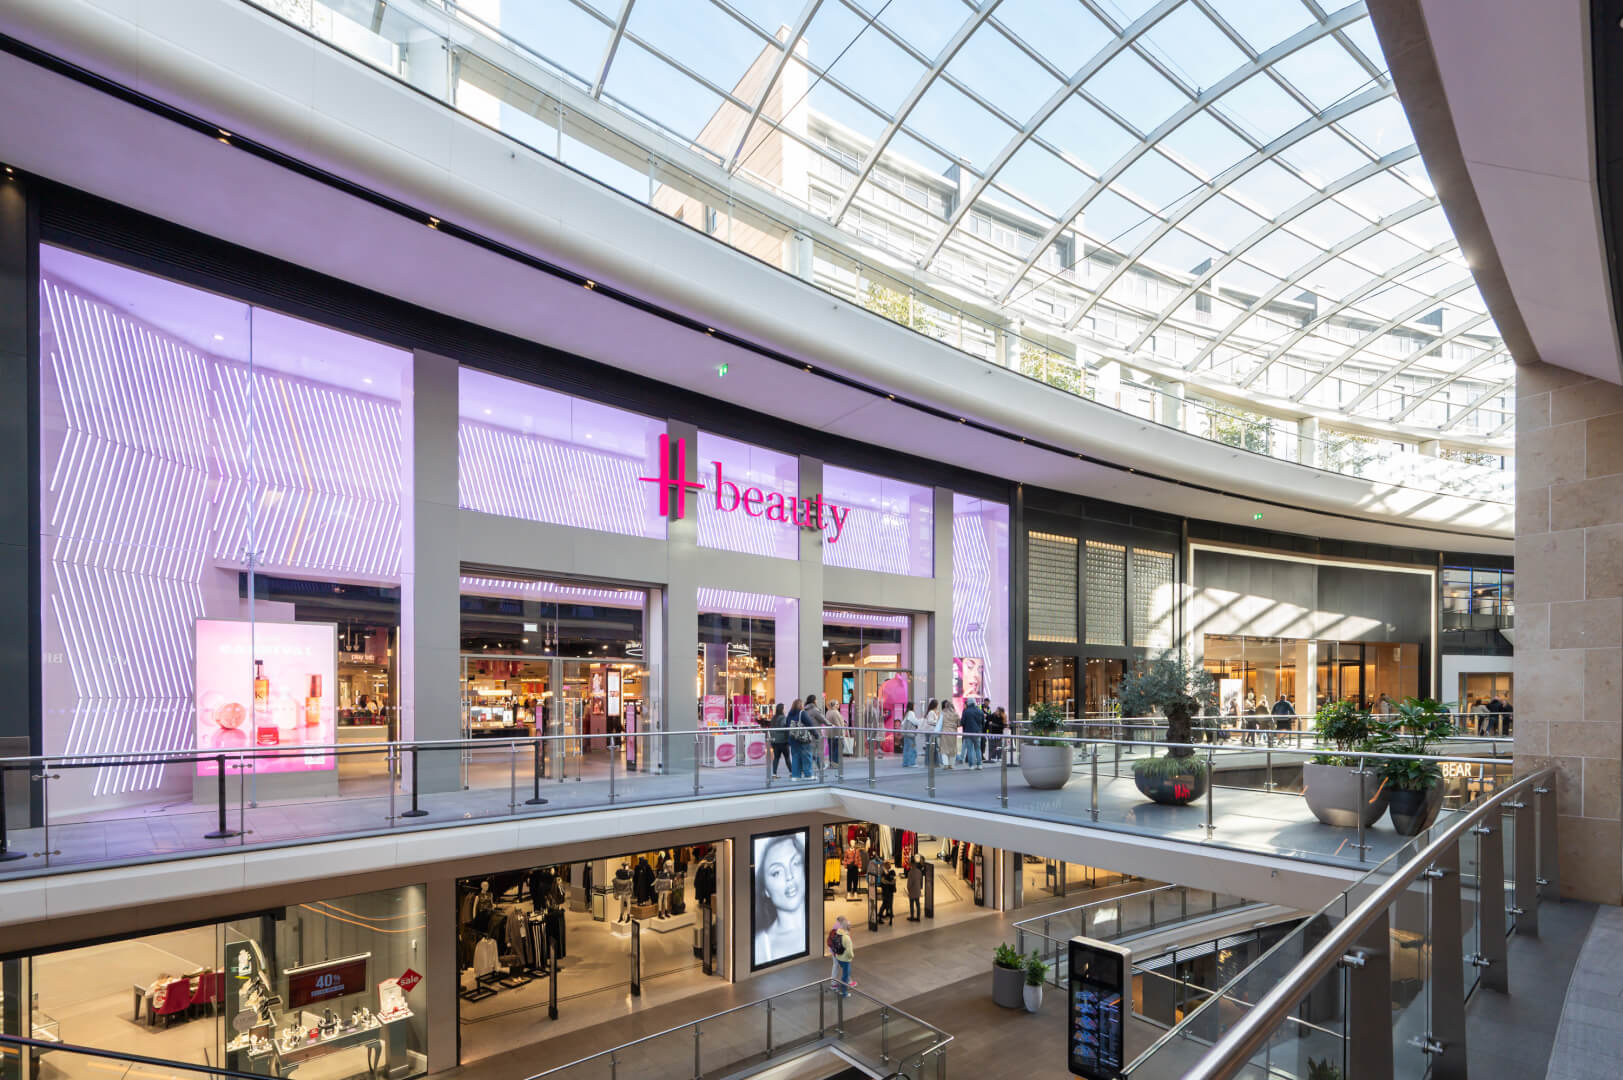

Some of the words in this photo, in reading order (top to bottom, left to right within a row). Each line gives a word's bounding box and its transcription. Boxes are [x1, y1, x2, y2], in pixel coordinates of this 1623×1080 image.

[638, 433, 705, 519] H
[711, 461, 851, 543] beauty
[1442, 762, 1472, 777] BEAR
[400, 975, 419, 986] sale
